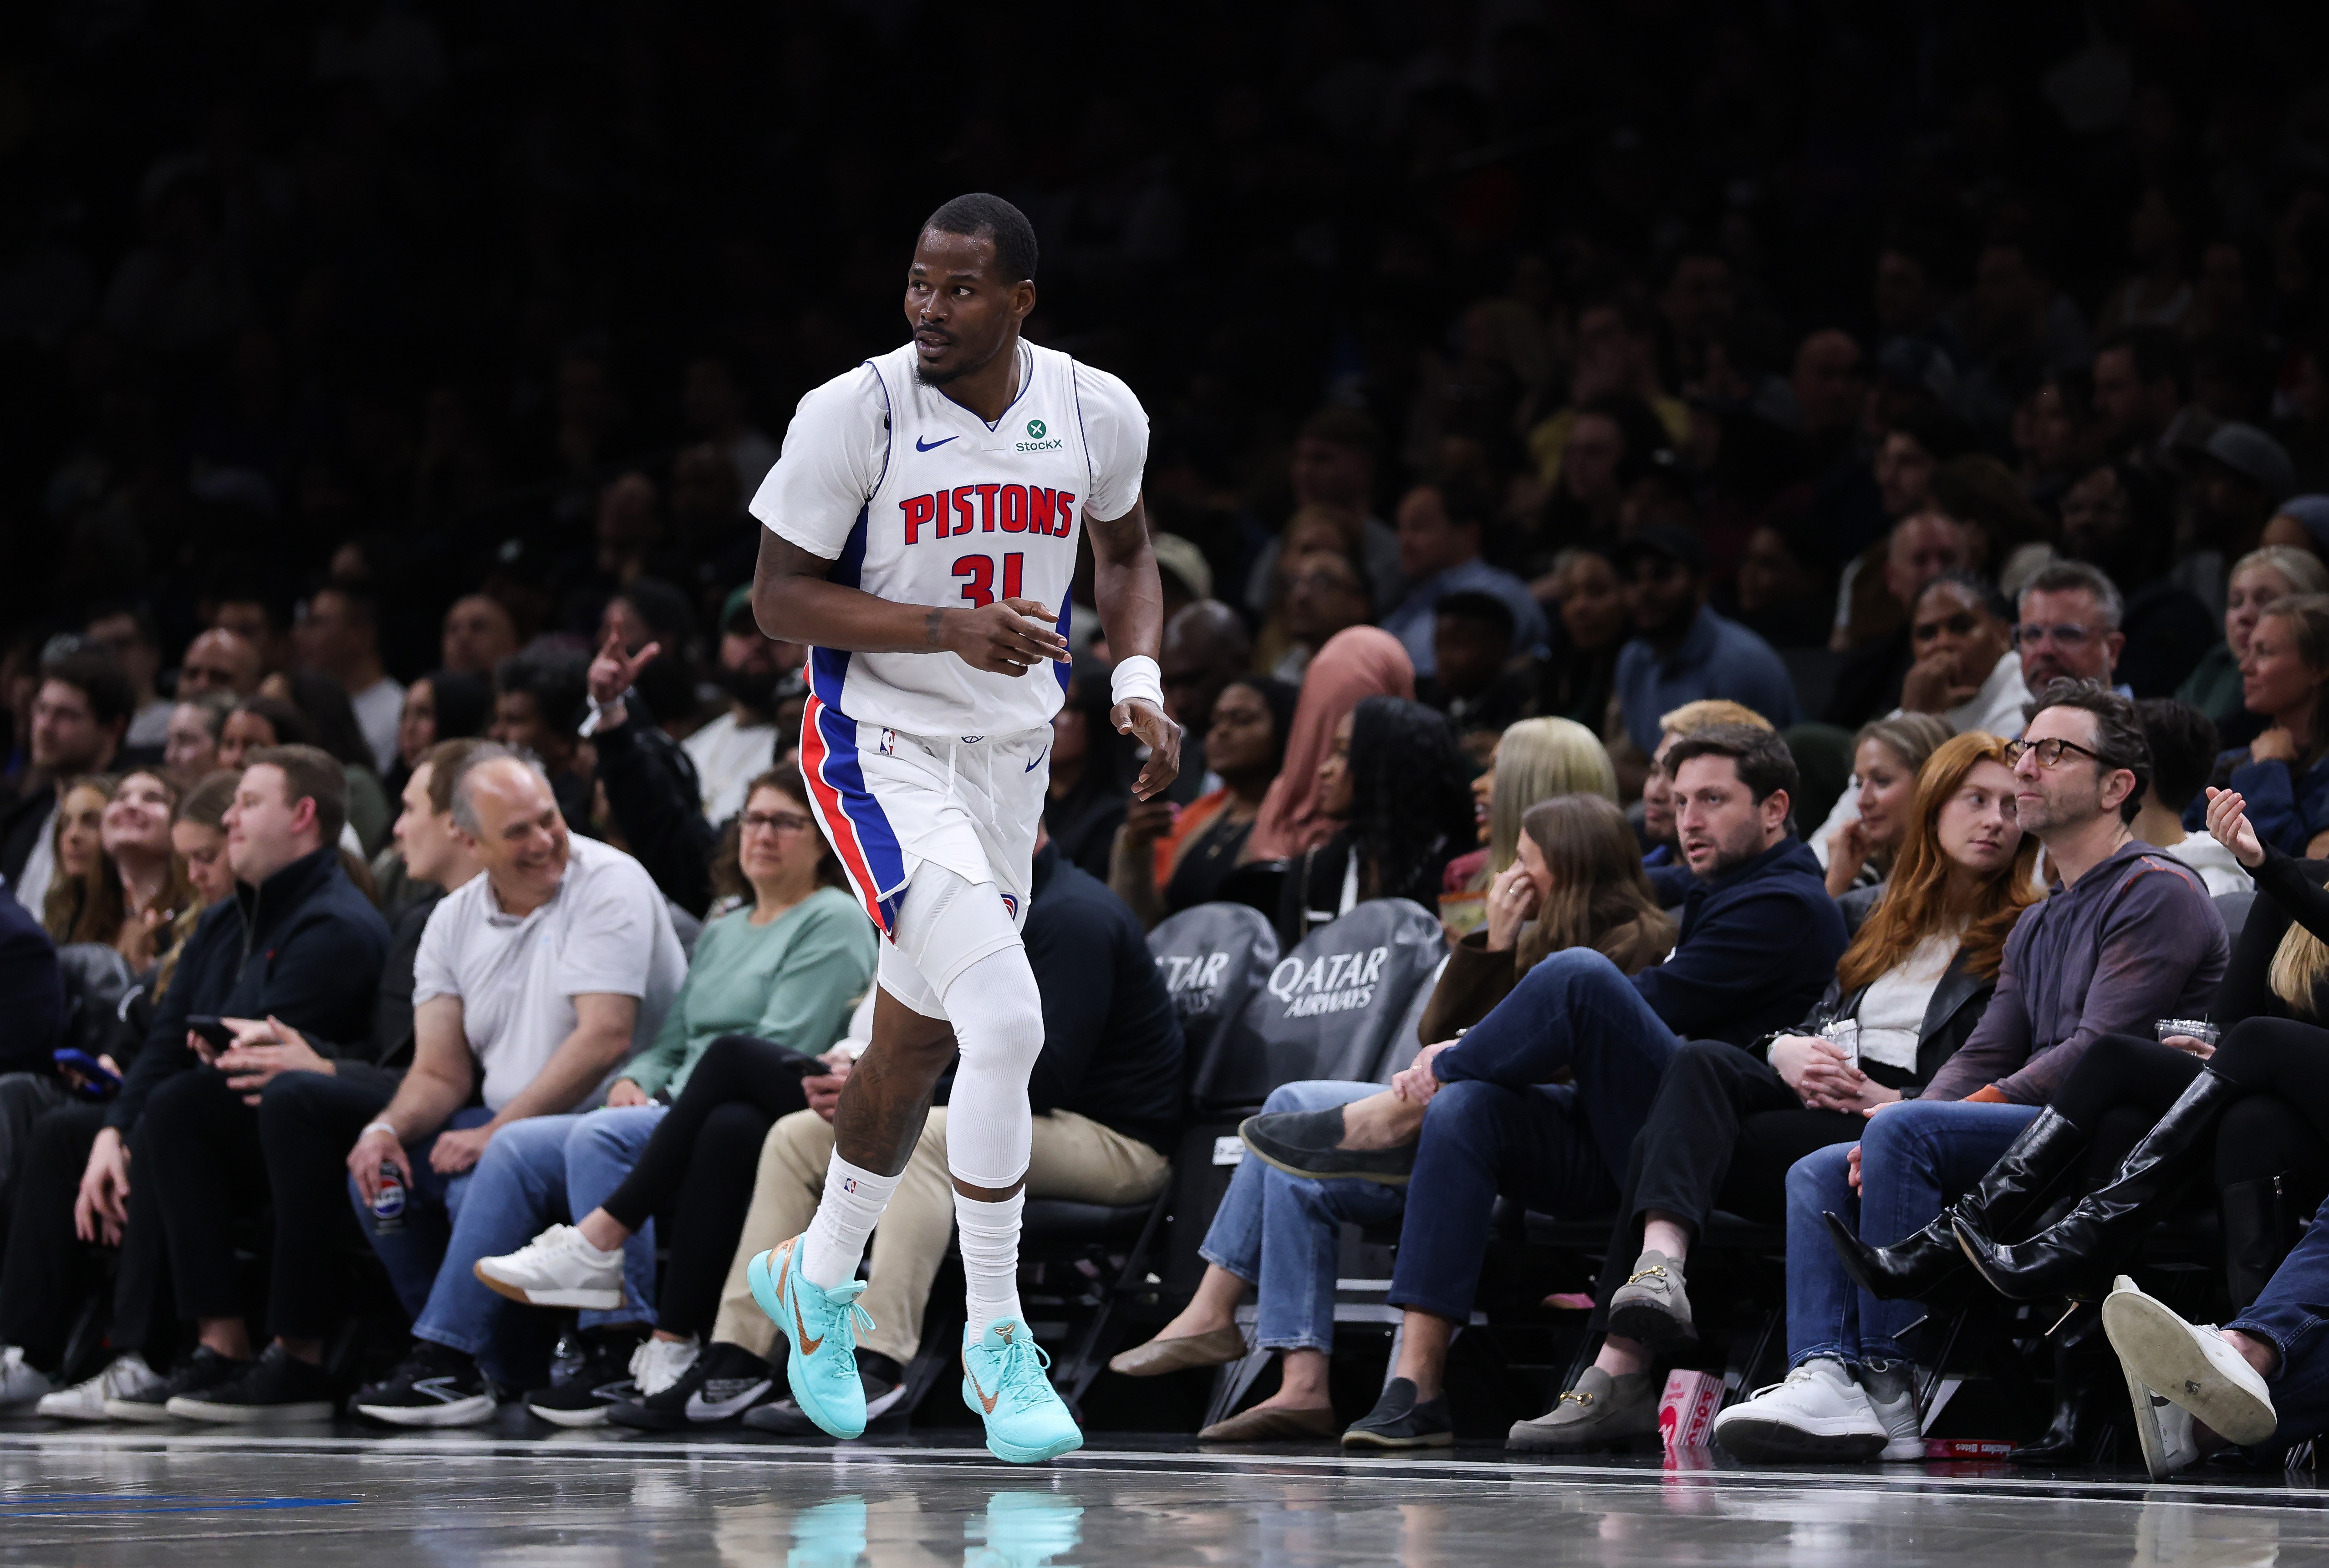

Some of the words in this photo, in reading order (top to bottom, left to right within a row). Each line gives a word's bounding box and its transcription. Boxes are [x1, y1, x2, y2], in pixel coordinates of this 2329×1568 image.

[1016, 438, 1062, 452] StockX
[899, 484, 1075, 545] PISTONS
[951, 552, 1024, 609] 31
[1155, 952, 1229, 993] TAR
[1268, 947, 1388, 1003] QATAR
[1284, 985, 1375, 1018] AIRWAYS
